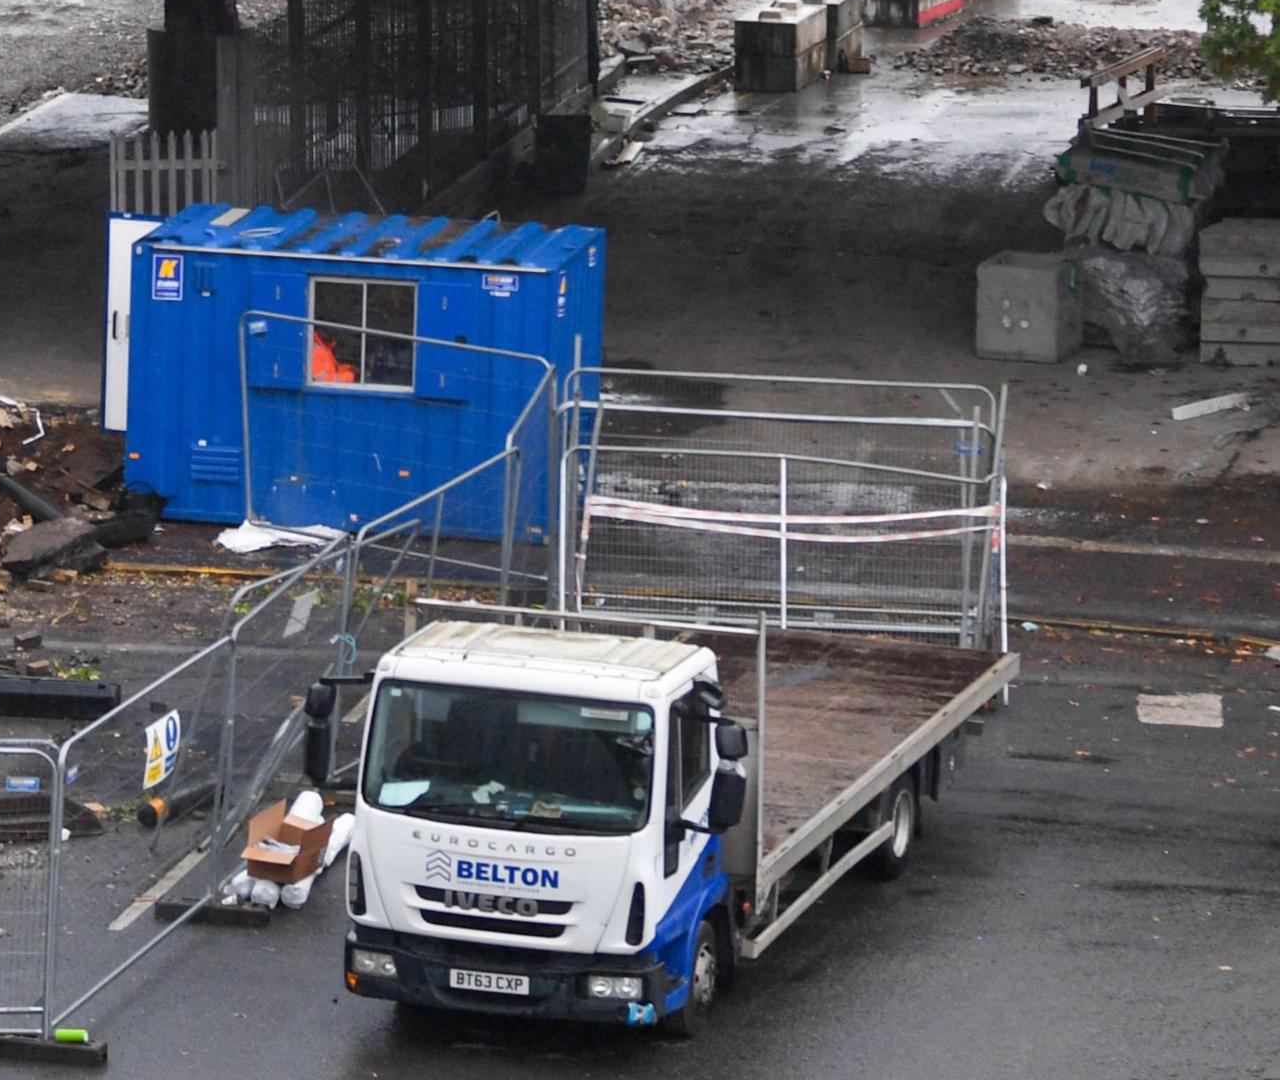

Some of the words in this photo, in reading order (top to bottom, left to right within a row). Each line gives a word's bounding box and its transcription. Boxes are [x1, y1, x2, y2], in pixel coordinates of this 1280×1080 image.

[412, 831, 577, 857] EUROCARGO
[456, 860, 560, 889] BELTON
[443, 889, 539, 917] IVECO
[456, 972, 492, 989] BT63
[495, 976, 524, 991] CXP
